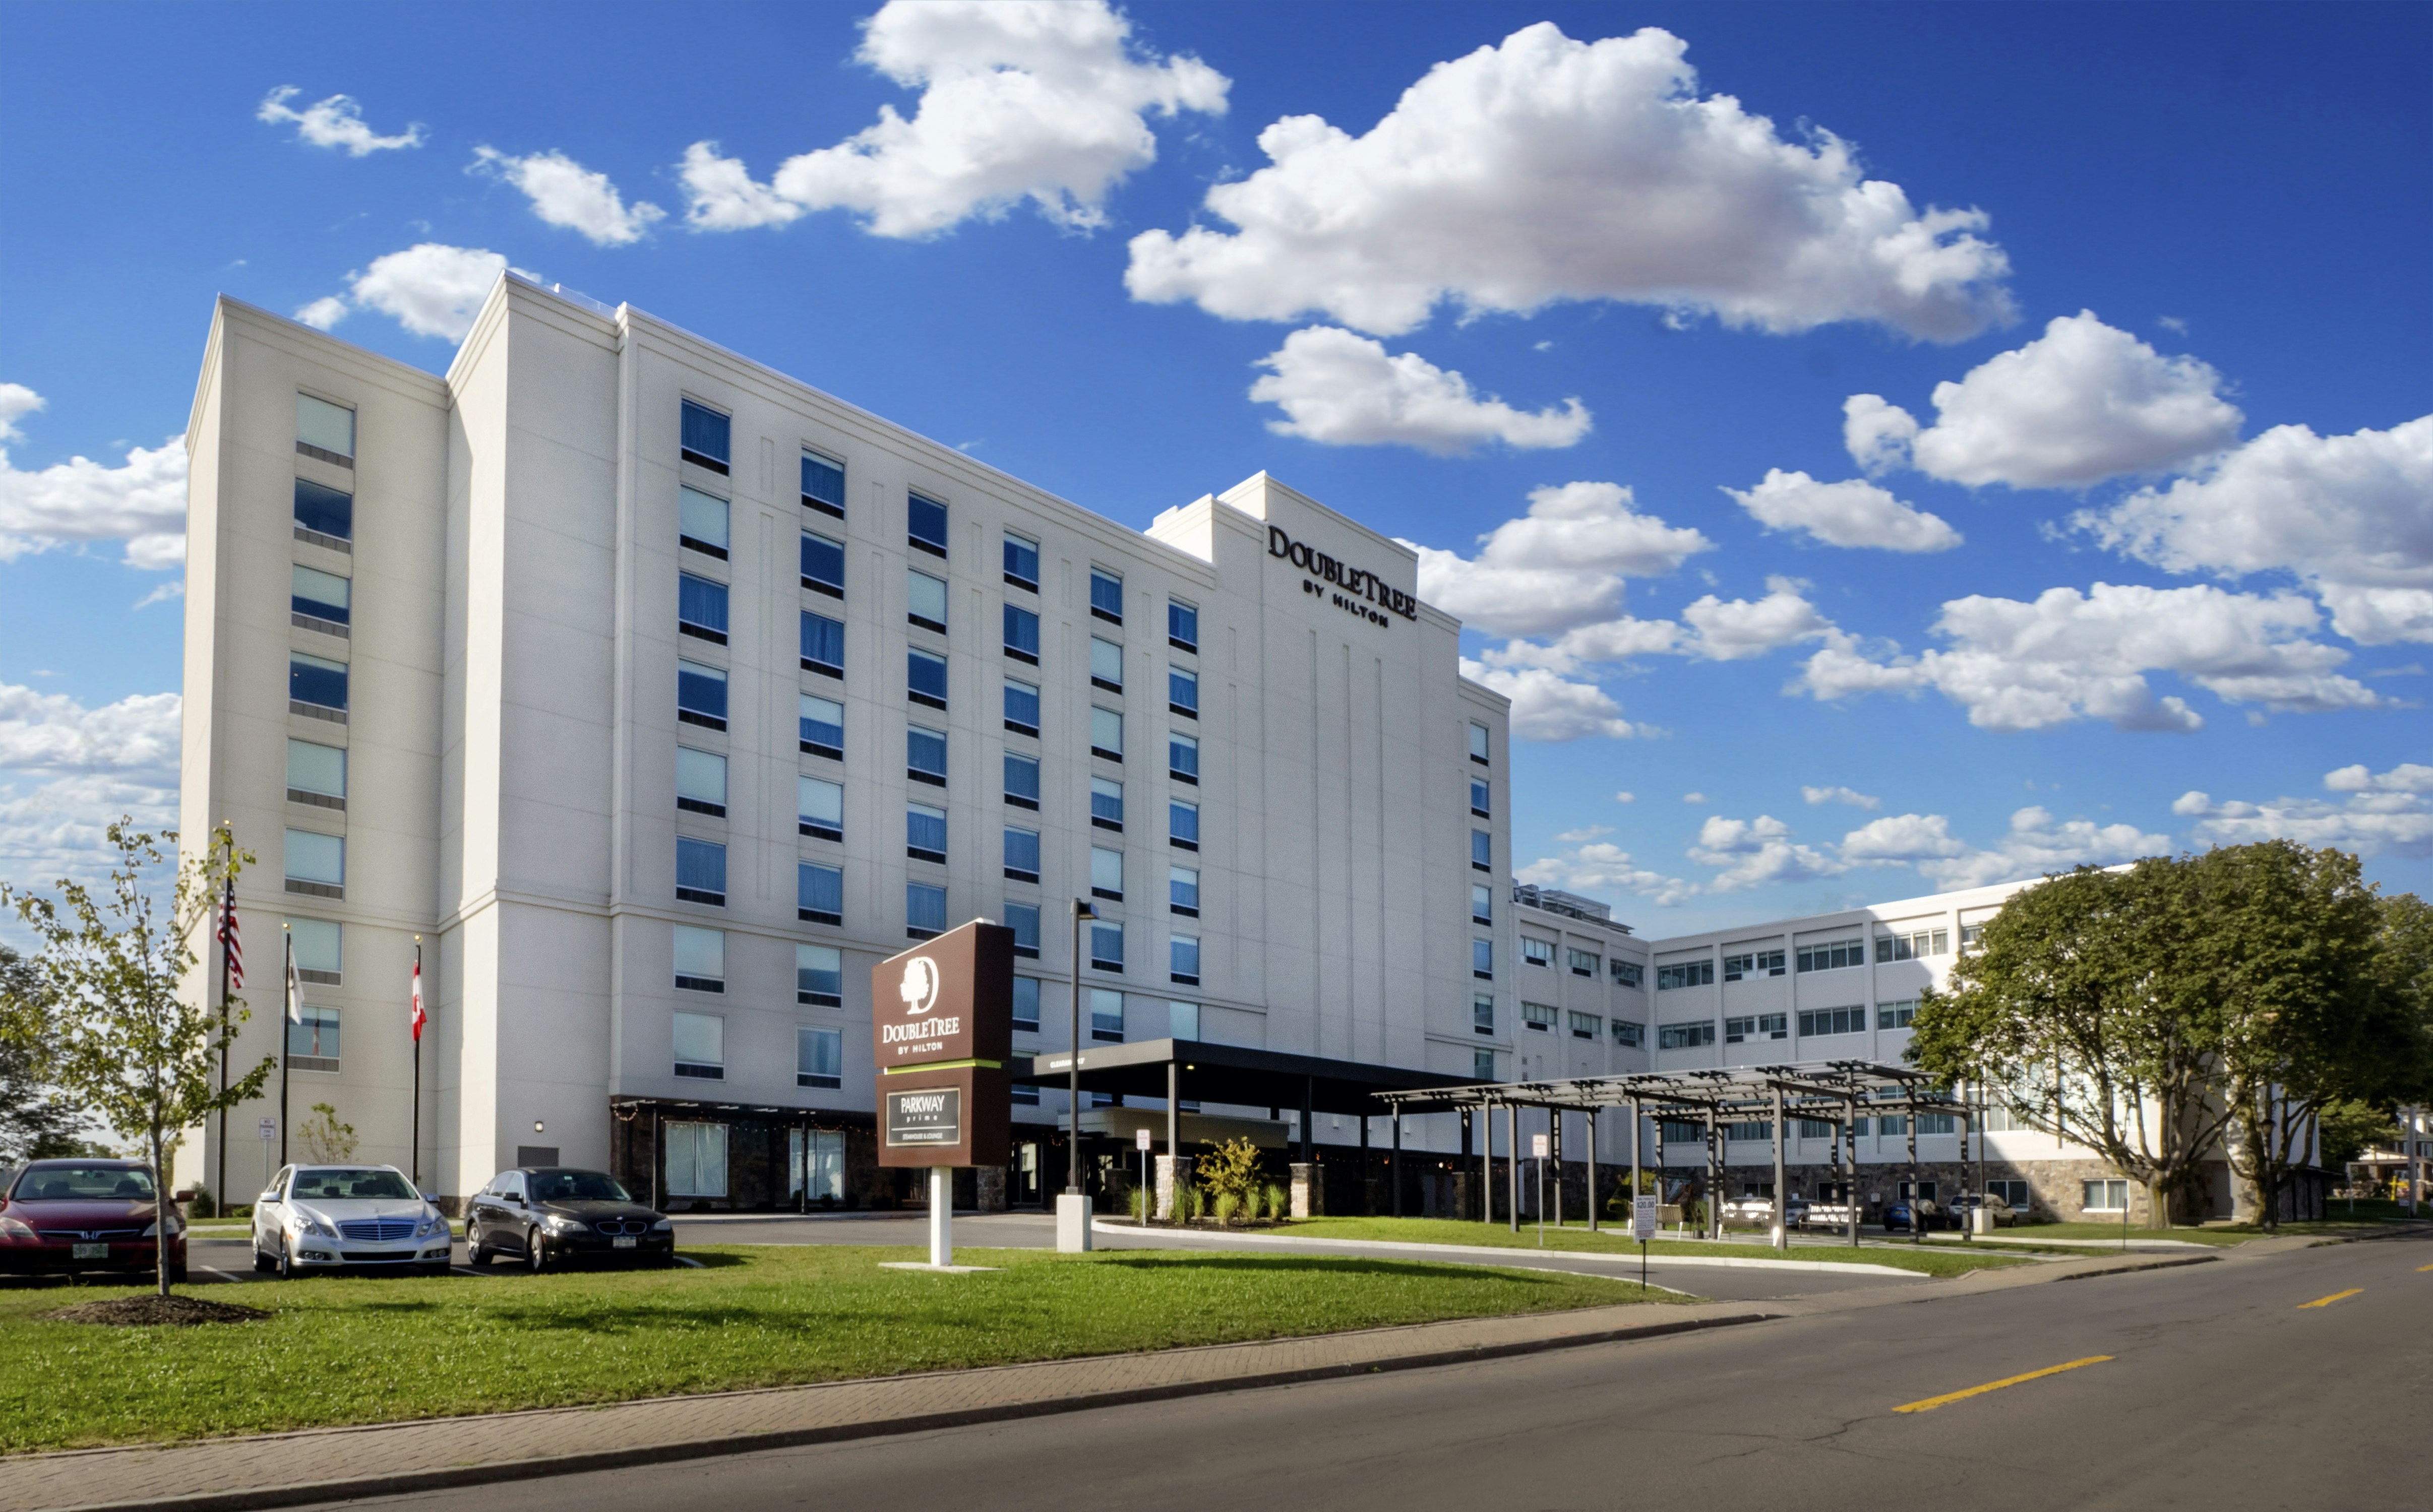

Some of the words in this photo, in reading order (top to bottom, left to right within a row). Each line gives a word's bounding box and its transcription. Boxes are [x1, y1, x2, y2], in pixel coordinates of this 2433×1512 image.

[1304, 579, 1324, 597] BY
[1333, 593, 1388, 627] HILTON
[898, 1046, 908, 1055] BY
[913, 1041, 943, 1053] HILTON
[1050, 1059, 1072, 1068] CLEARAN
[901, 1095, 945, 1114] PARKWAY
